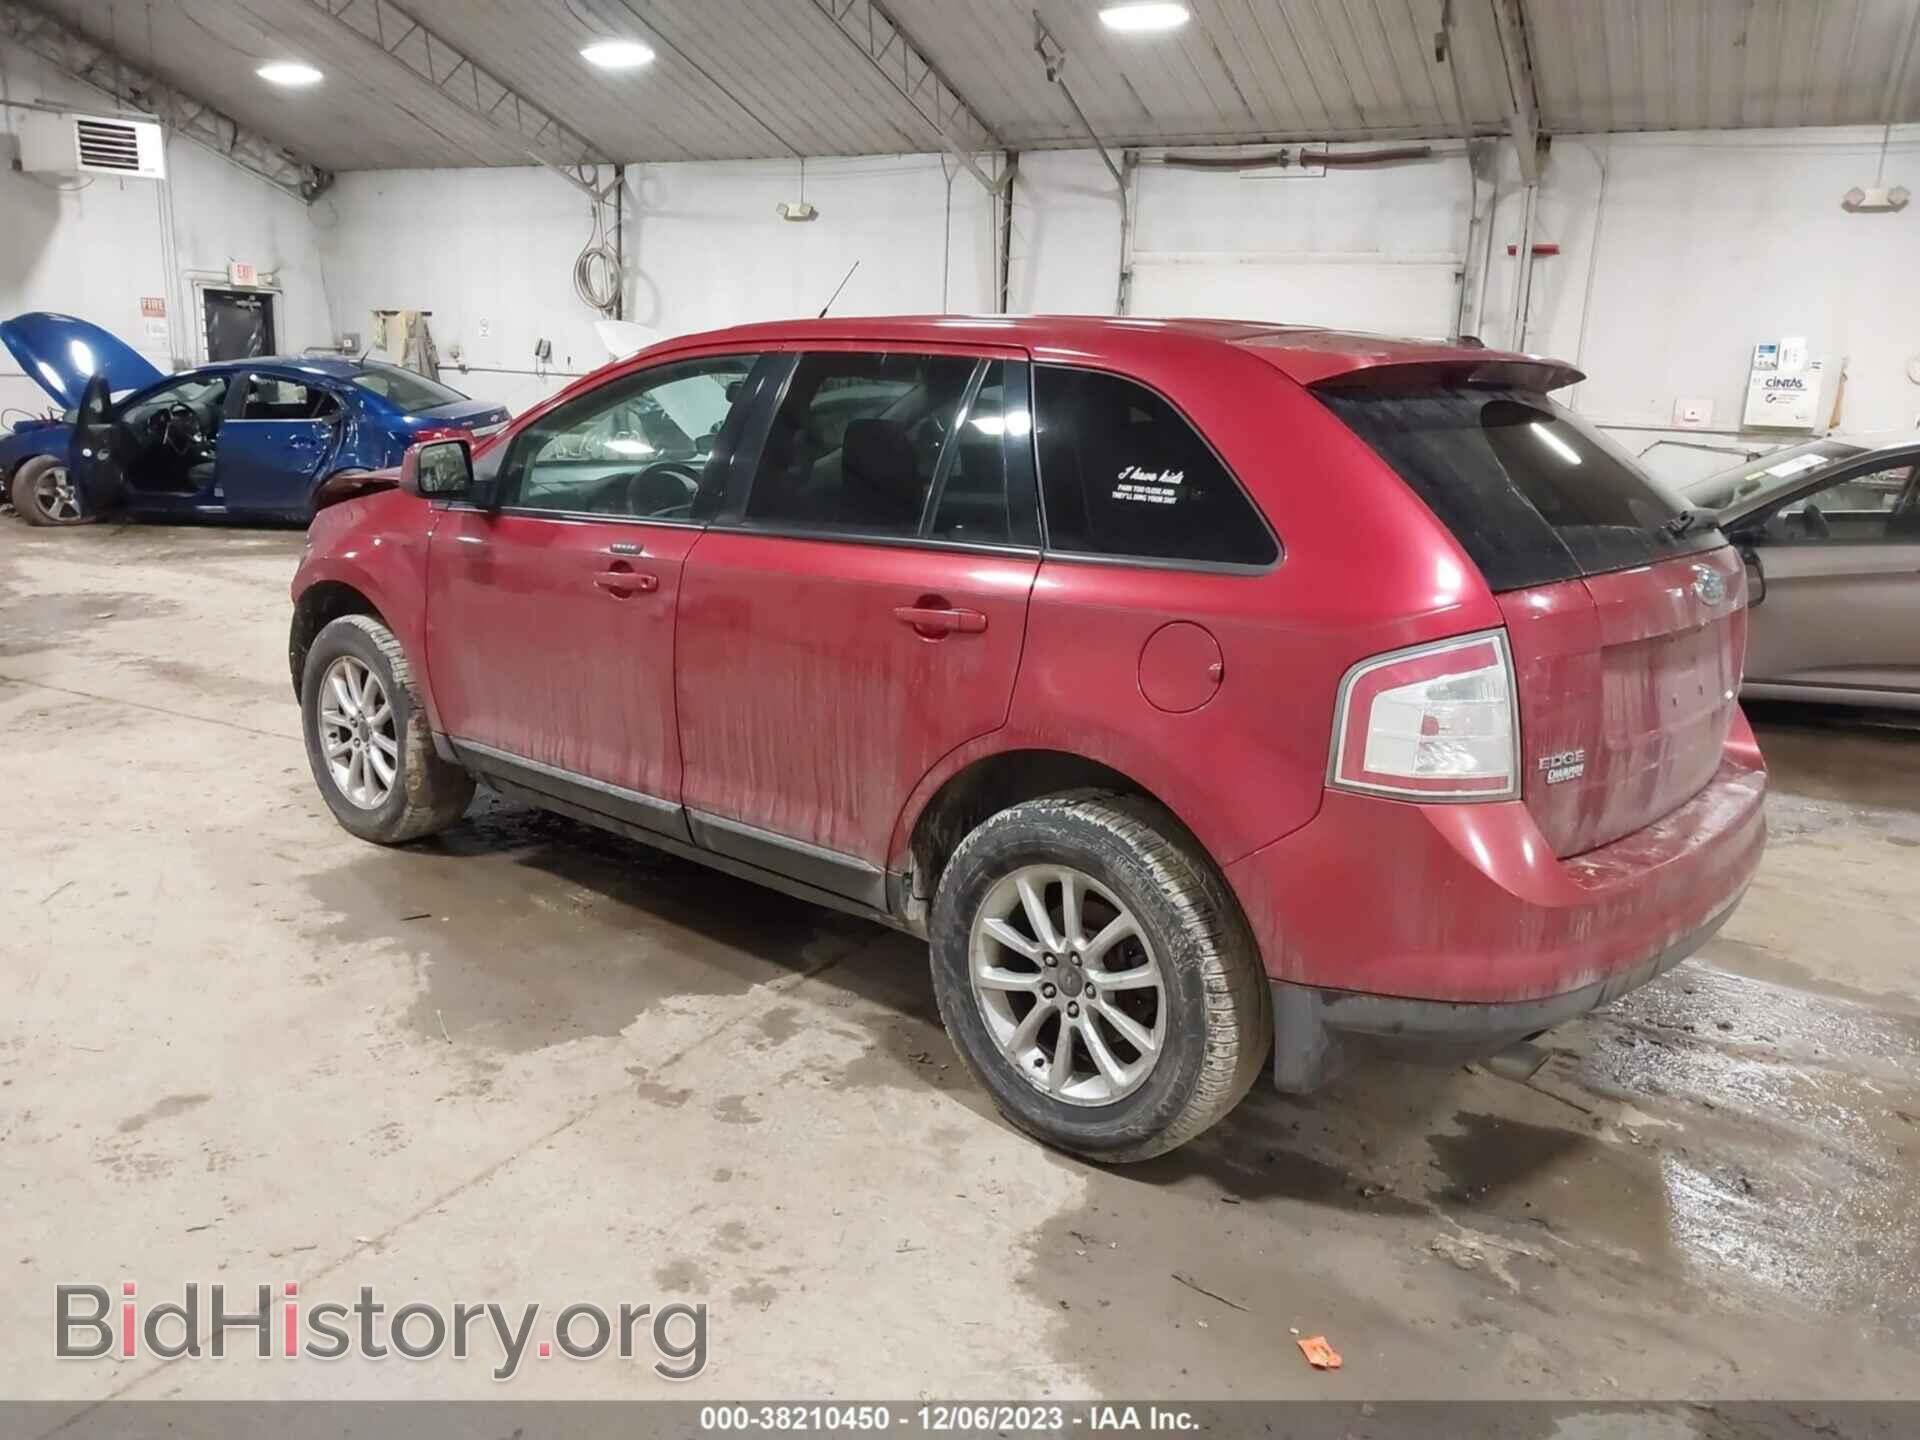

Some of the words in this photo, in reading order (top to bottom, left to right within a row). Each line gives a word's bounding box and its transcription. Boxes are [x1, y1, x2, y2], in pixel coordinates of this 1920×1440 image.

[236, 263, 255, 281] EXIT
[141, 298, 165, 311] FIRE
[1538, 750, 1584, 770] EDGE
